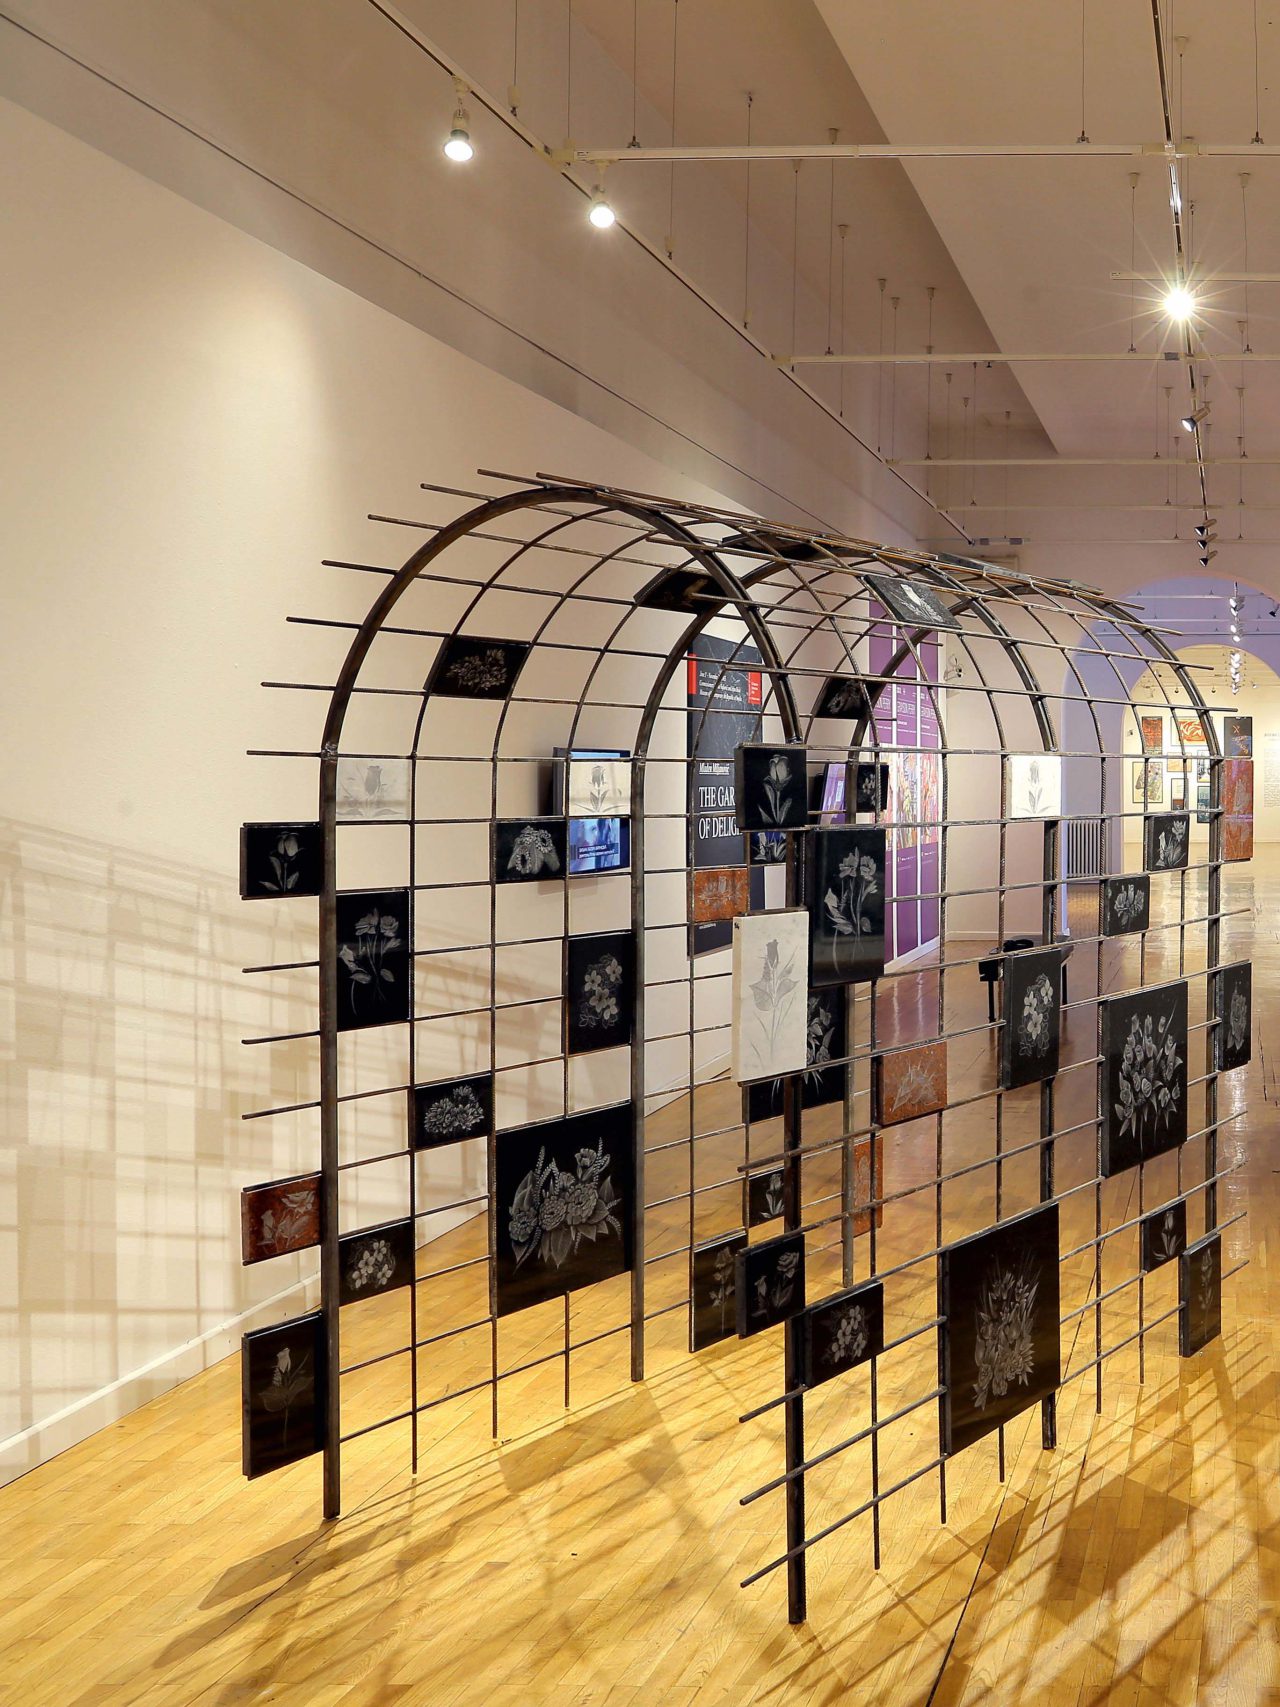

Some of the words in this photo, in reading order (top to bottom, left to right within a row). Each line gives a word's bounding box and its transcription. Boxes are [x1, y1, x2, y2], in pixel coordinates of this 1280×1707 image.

[699, 786, 717, 807] THE
[717, 786, 735, 807] GAR
[699, 818, 711, 839] OF
[712, 816, 742, 838] DELIG
